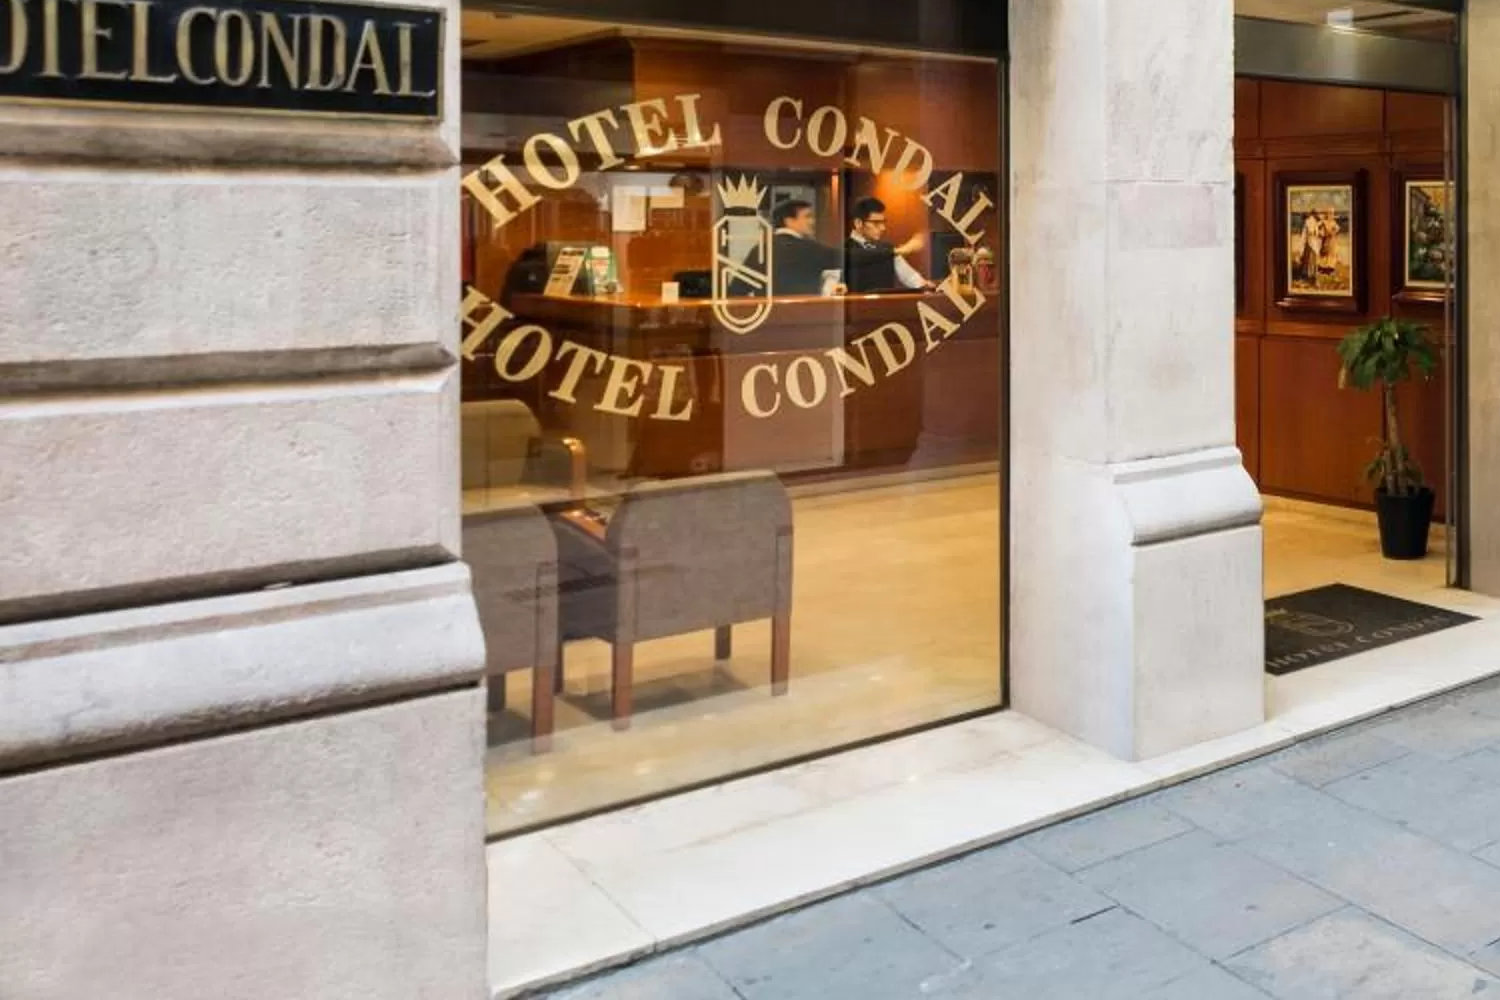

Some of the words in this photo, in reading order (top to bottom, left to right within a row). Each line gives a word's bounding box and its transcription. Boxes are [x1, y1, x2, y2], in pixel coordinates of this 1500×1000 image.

[461, 94, 722, 229] HOTEL
[763, 96, 994, 246] CONDAL
[460, 284, 694, 421] HOTEL
[740, 265, 987, 419] CONDAL
